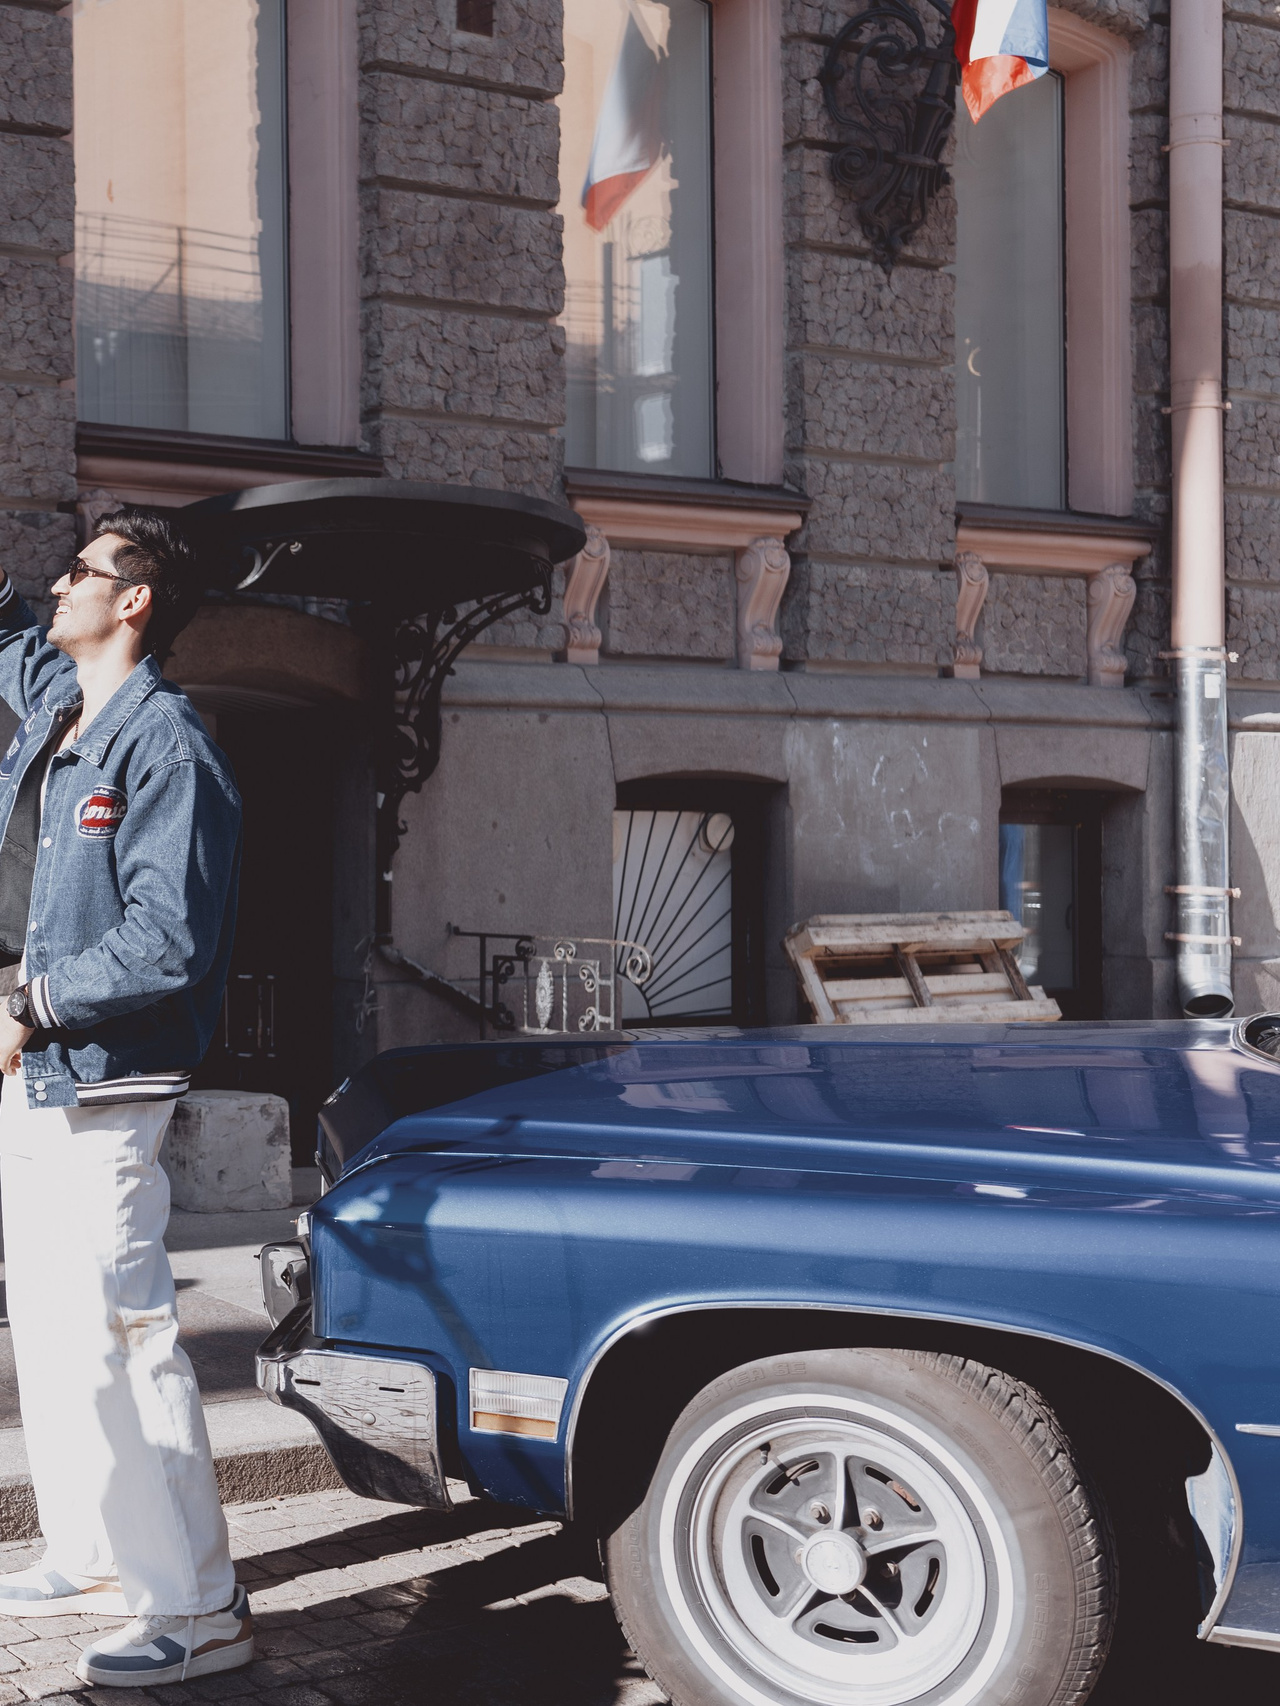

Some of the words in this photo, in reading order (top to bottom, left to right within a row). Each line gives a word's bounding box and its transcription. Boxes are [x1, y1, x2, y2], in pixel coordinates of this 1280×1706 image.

[628, 1505, 643, 1578] COOP
[1027, 1572, 1050, 1655] STEEL
[1000, 1662, 1037, 1706] BEL
